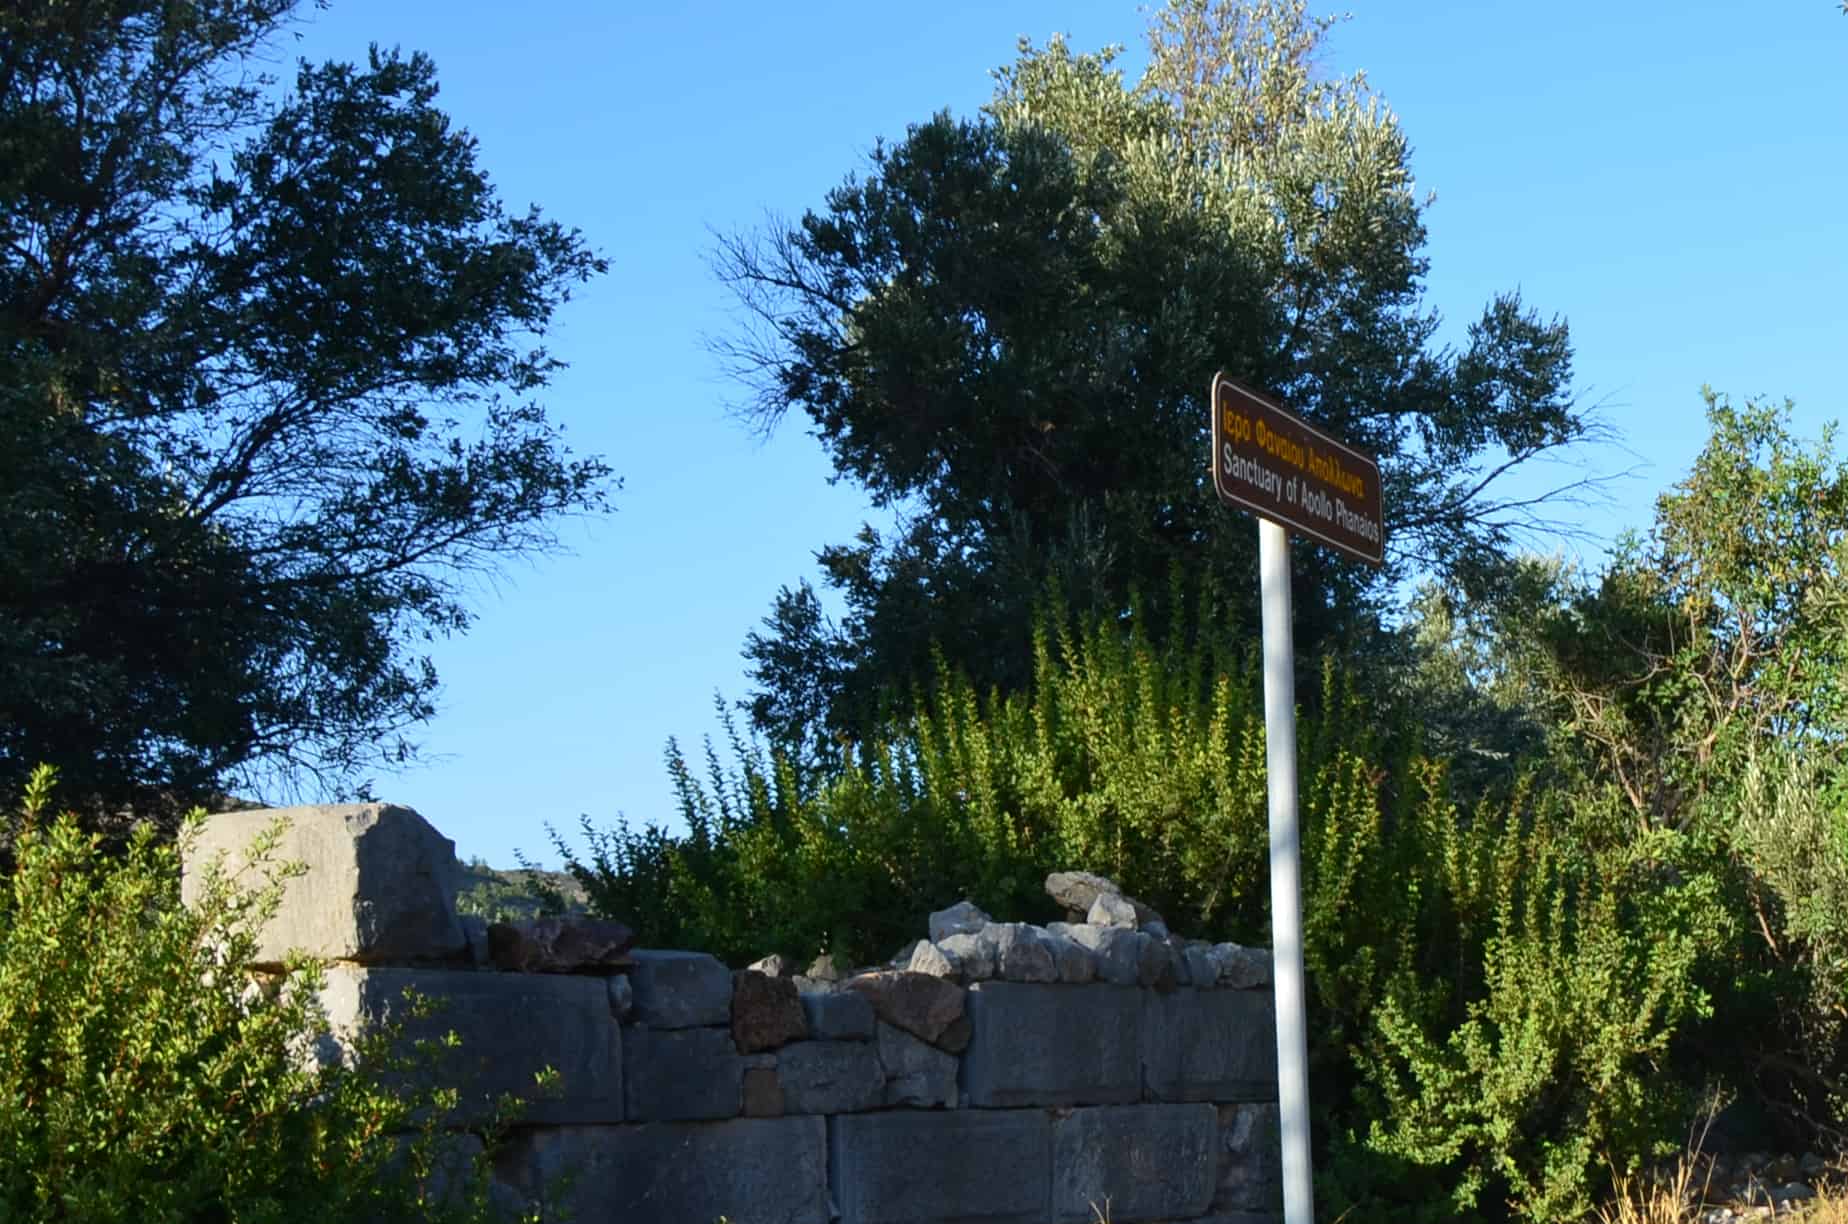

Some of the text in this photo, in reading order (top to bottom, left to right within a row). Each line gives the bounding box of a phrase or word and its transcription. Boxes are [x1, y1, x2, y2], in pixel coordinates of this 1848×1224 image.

[1223, 442, 1379, 543] Sanctuary of Apollo Phanaios
